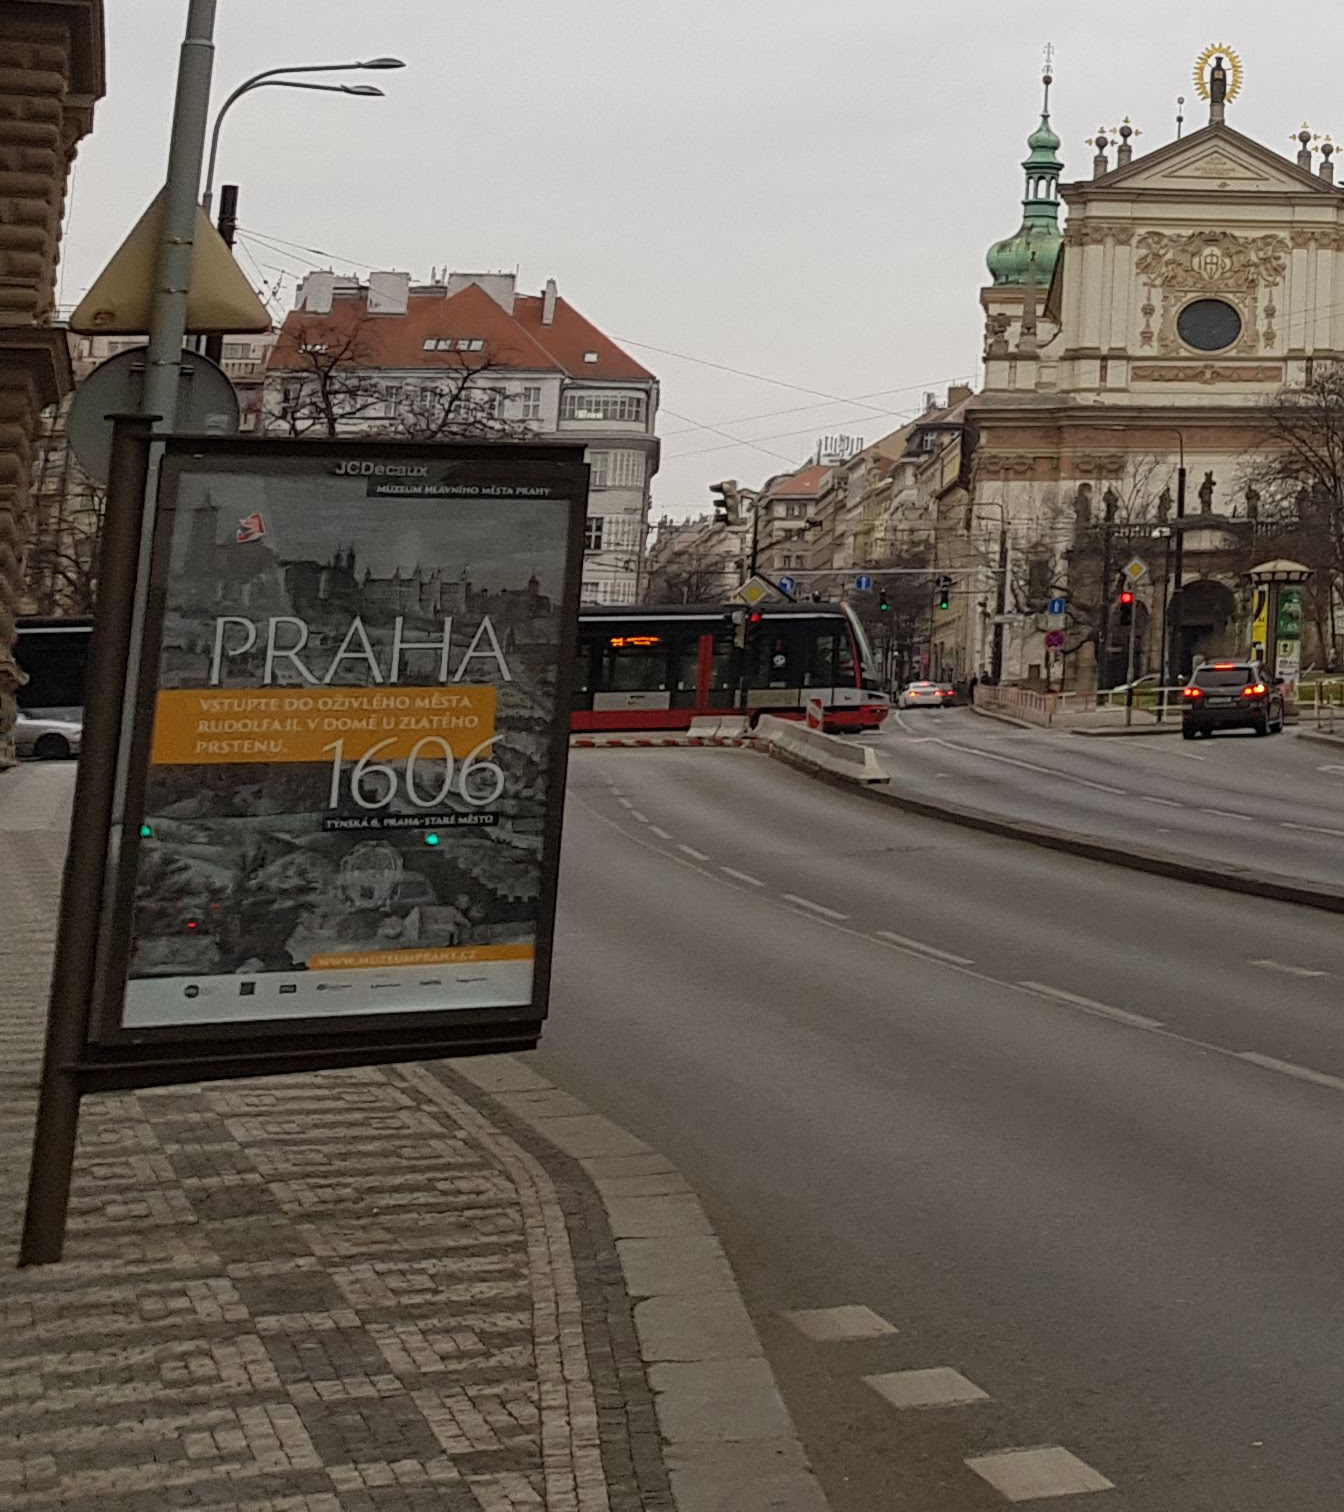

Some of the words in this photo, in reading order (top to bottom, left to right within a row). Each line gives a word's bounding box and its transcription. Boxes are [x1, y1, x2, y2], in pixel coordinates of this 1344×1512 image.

[334, 460, 429, 479] JCDecaux
[376, 484, 423, 496] MUZEUM
[424, 484, 480, 496] HLAVNÍHO
[482, 485, 515, 496] MĚSTA
[516, 486, 552, 498] PRAHY
[209, 614, 513, 686] PRAHA
[201, 697, 280, 713] VSTUPTE
[284, 697, 315, 712] DO
[318, 692, 410, 711] OŽIVLÉHO
[414, 690, 473, 710] MĚSTA
[197, 718, 283, 734] RUDOLFA
[305, 716, 321, 731] V
[323, 712, 379, 731] DOMĚ
[382, 714, 397, 729] U
[399, 709, 480, 728] ZLATÉHO
[195, 738, 289, 755] PRSTENU.
[322, 734, 507, 810] 1606
[326, 816, 368, 829] TÝNSKÁ
[383, 814, 456, 827] PRAHA-STARÉ
[458, 813, 494, 825] MĚSTO
[319, 949, 476, 967] WWW.MUZEUMPRAHY.CZ
